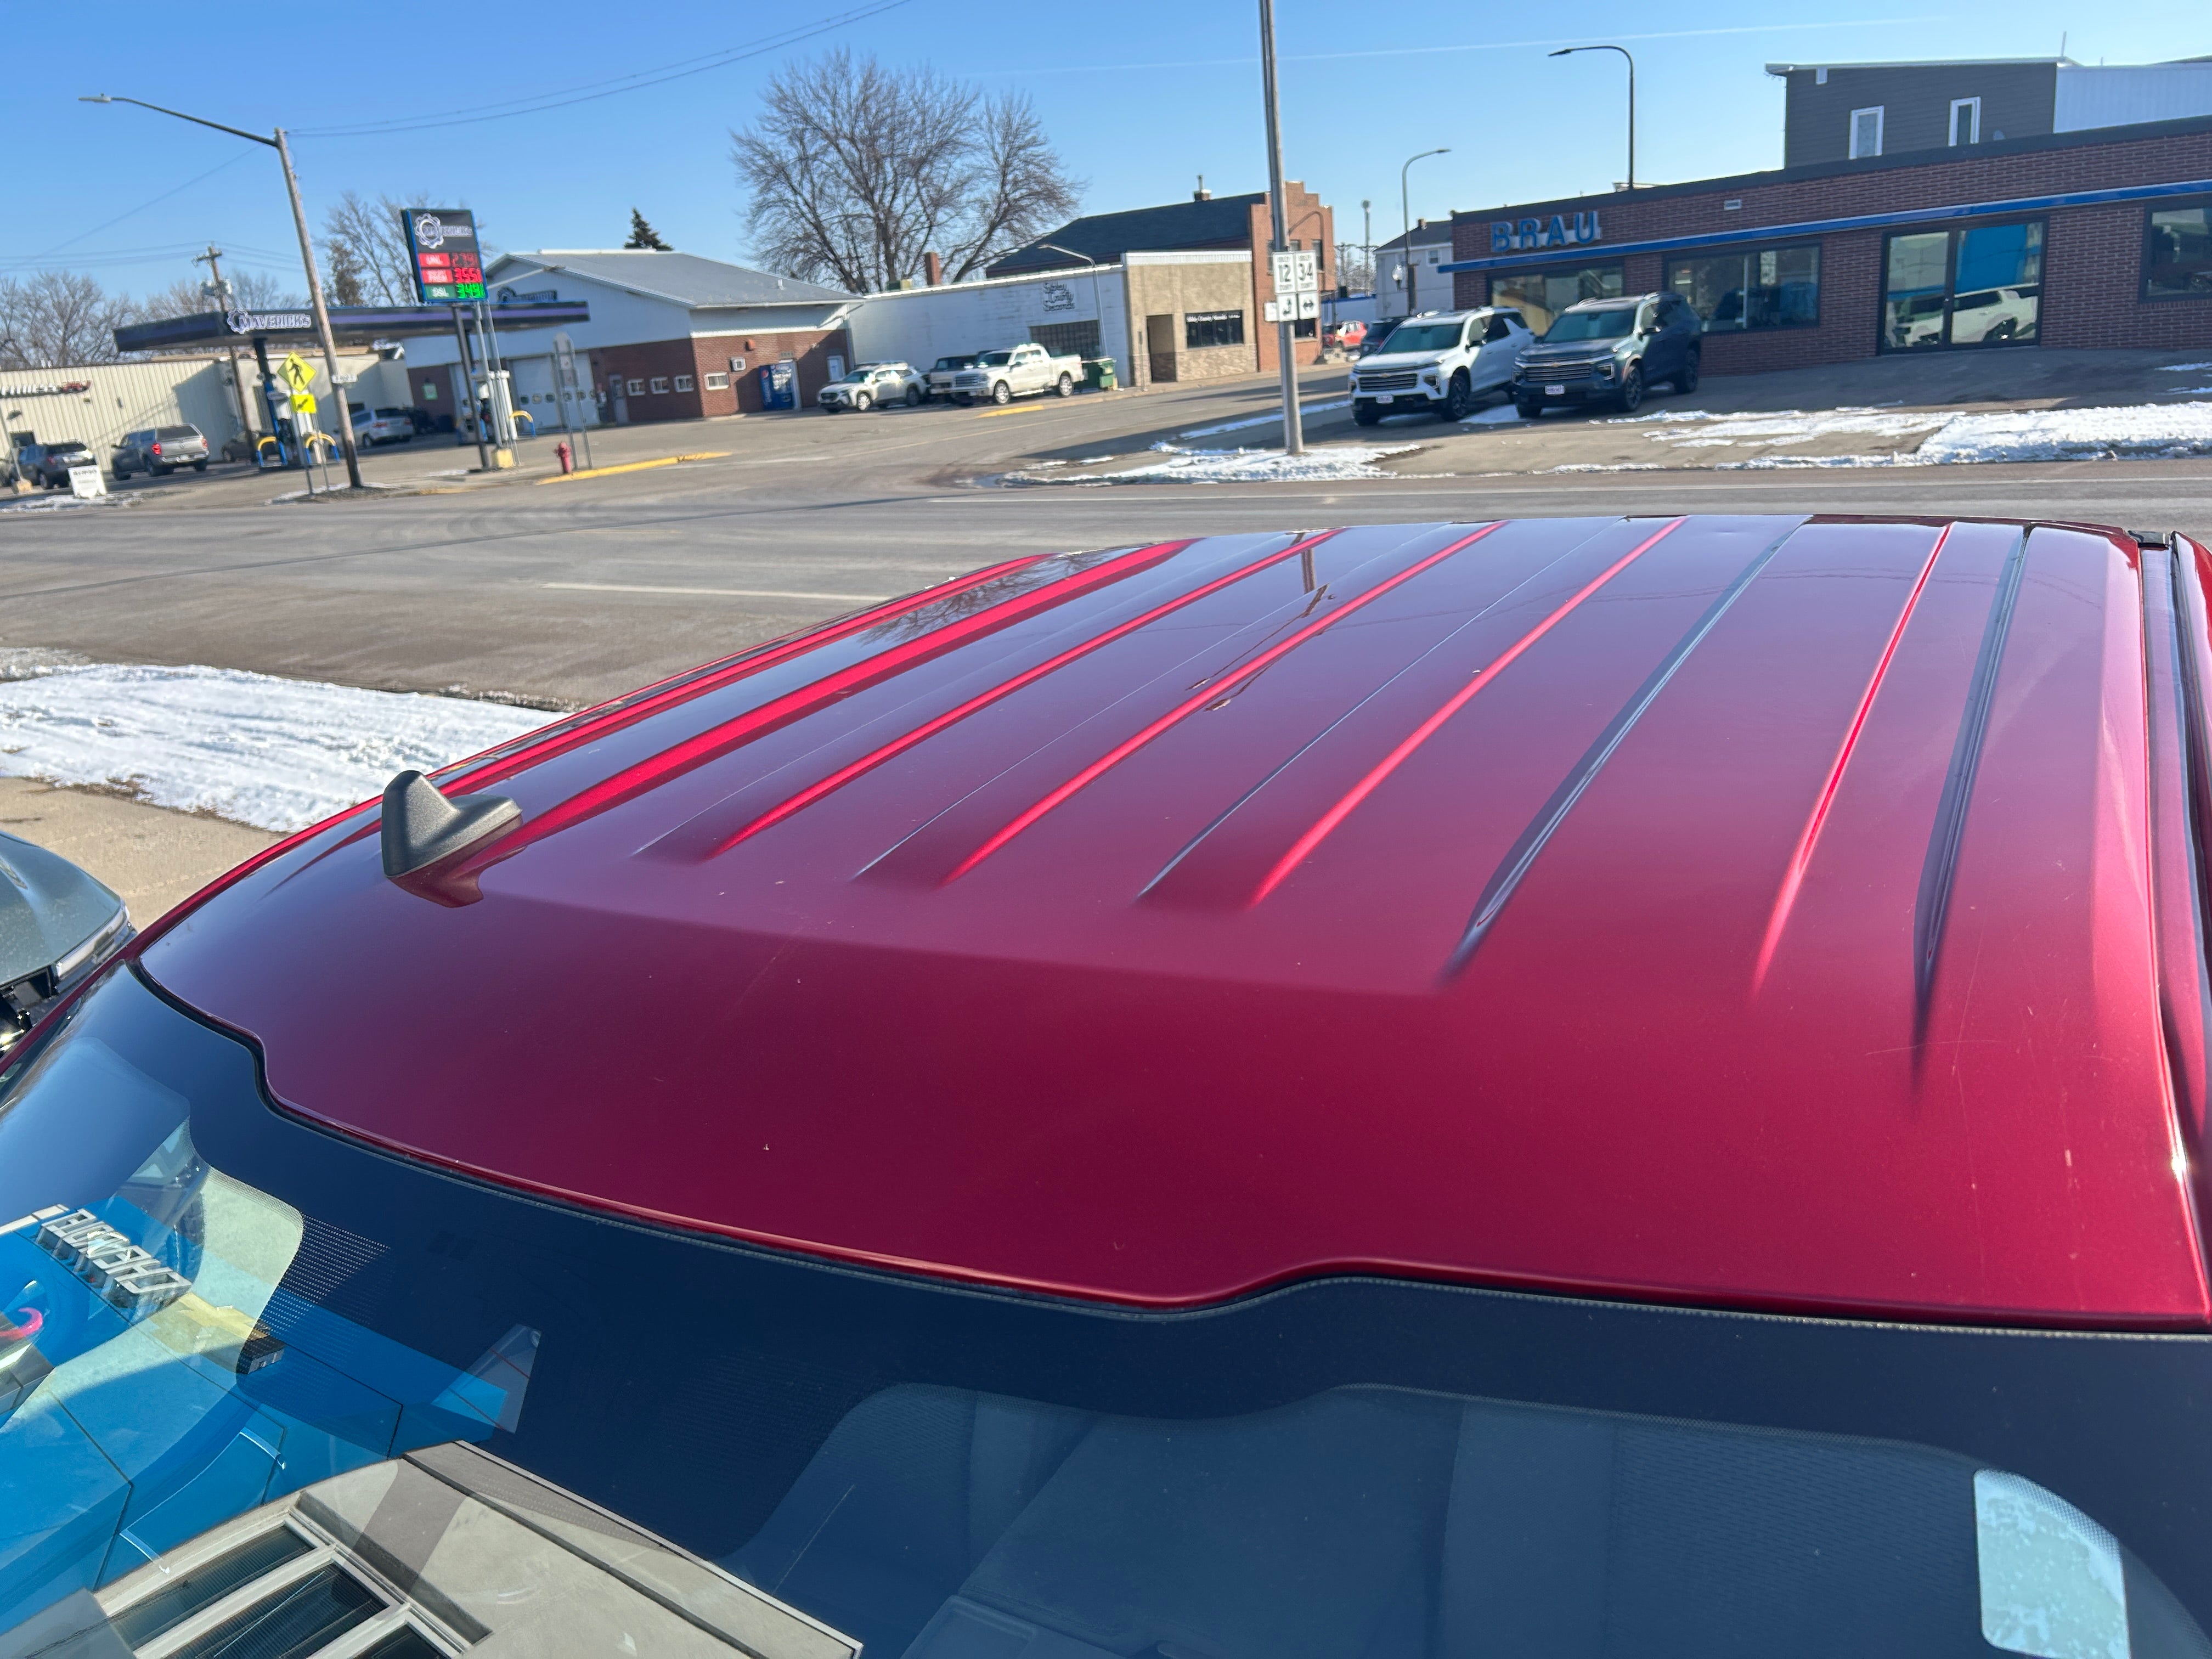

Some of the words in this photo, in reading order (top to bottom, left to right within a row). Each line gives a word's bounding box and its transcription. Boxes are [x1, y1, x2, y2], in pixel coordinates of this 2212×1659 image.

[1491, 211, 1599, 252] BRAU
[1278, 264, 1291, 283] 12
[1298, 262, 1314, 281] 34
